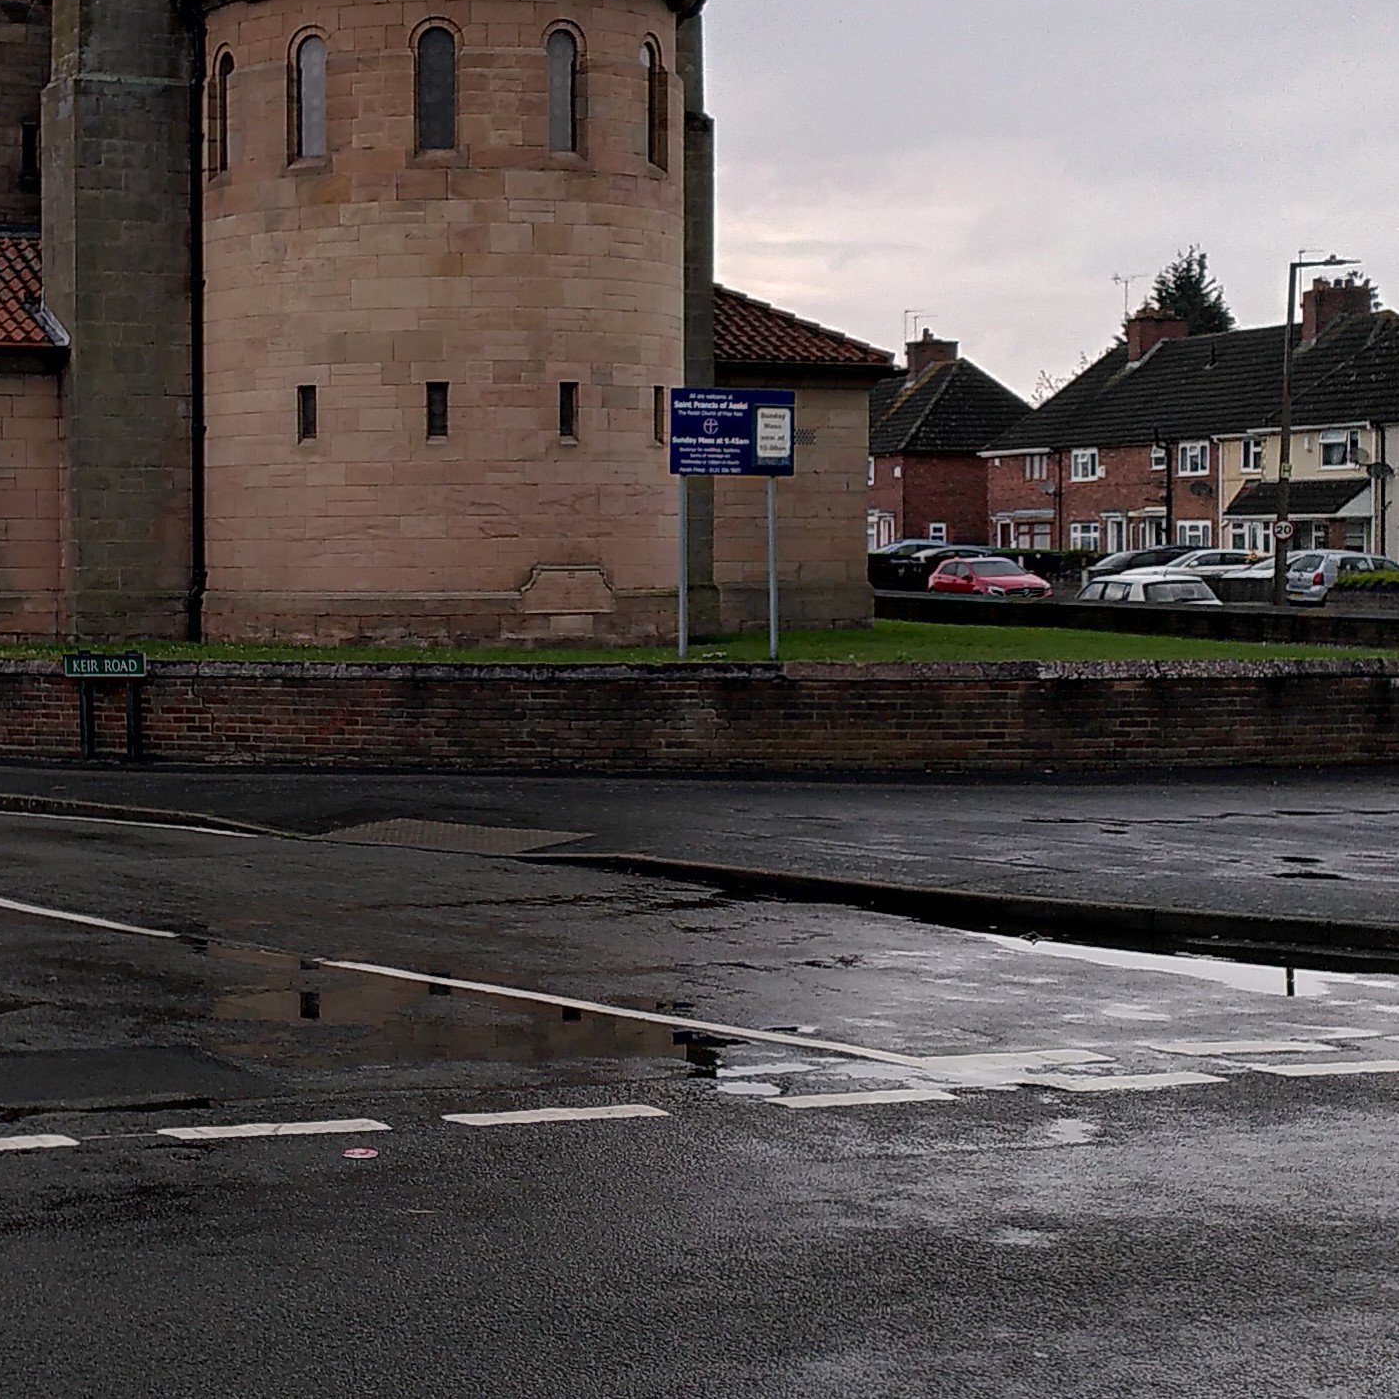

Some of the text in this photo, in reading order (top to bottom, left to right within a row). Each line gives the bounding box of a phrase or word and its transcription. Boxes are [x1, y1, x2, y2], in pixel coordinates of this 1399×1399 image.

[673, 400, 748, 410] Saint Francis of Assisi
[760, 412, 786, 421] Sunday
[672, 436, 697, 445] Sunday
[698, 436, 715, 444] Mass
[1276, 525, 1292, 535] 20
[72, 659, 138, 672] KEIR ROAD
